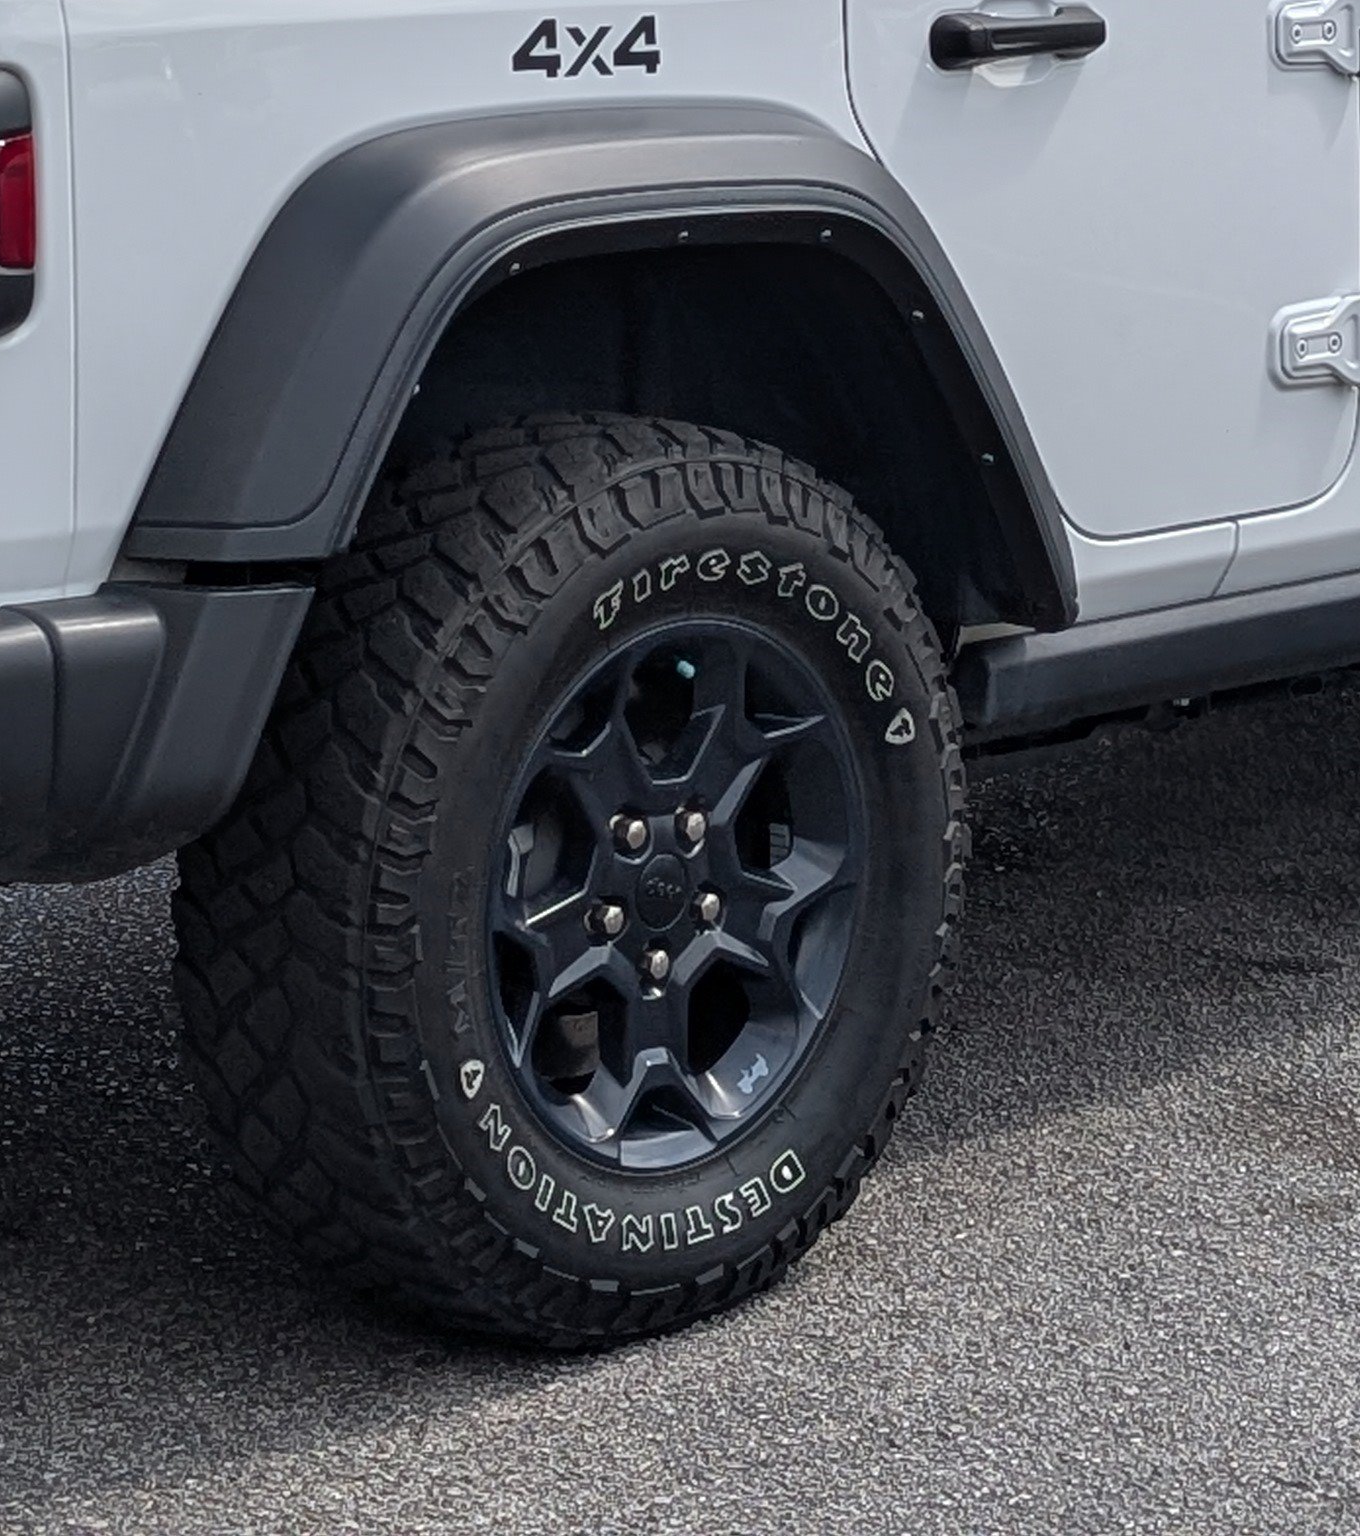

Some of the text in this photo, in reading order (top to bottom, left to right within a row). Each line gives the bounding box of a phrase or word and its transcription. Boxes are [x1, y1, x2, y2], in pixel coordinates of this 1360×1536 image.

[512, 15, 660, 78] 4x4
[593, 548, 894, 702] Firestone
[479, 1103, 806, 1252] DESTINATION
